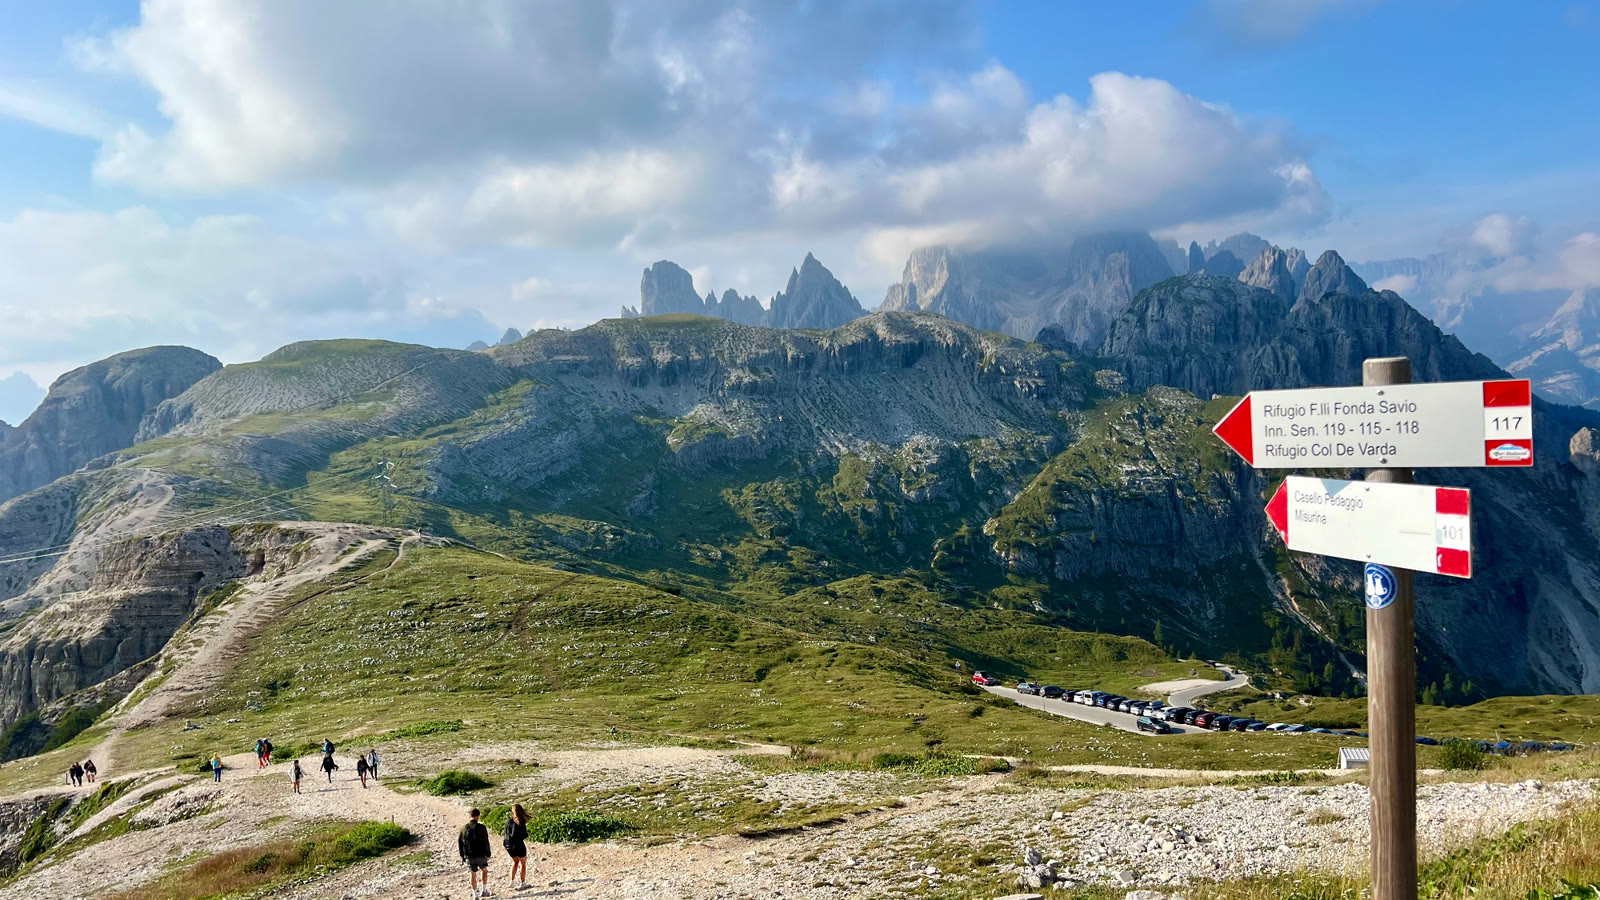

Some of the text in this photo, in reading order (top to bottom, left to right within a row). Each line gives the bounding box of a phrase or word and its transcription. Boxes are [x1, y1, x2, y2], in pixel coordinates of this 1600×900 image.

[1264, 400, 1417, 420] Rifugio F.lli Fonda Savio
[1264, 425, 1287, 437] Inn.
[1290, 423, 1319, 437] Sen.
[1323, 422, 1346, 436] 119
[1359, 421, 1382, 435] 115
[1396, 420, 1420, 434] 118
[1492, 416, 1522, 431] 117
[1265, 442, 1397, 460] Rifugio Col De Varda
[1294, 490, 1363, 511] Casello Pedaggio
[1295, 509, 1327, 524] Misurina
[1442, 524, 1464, 541] 101
